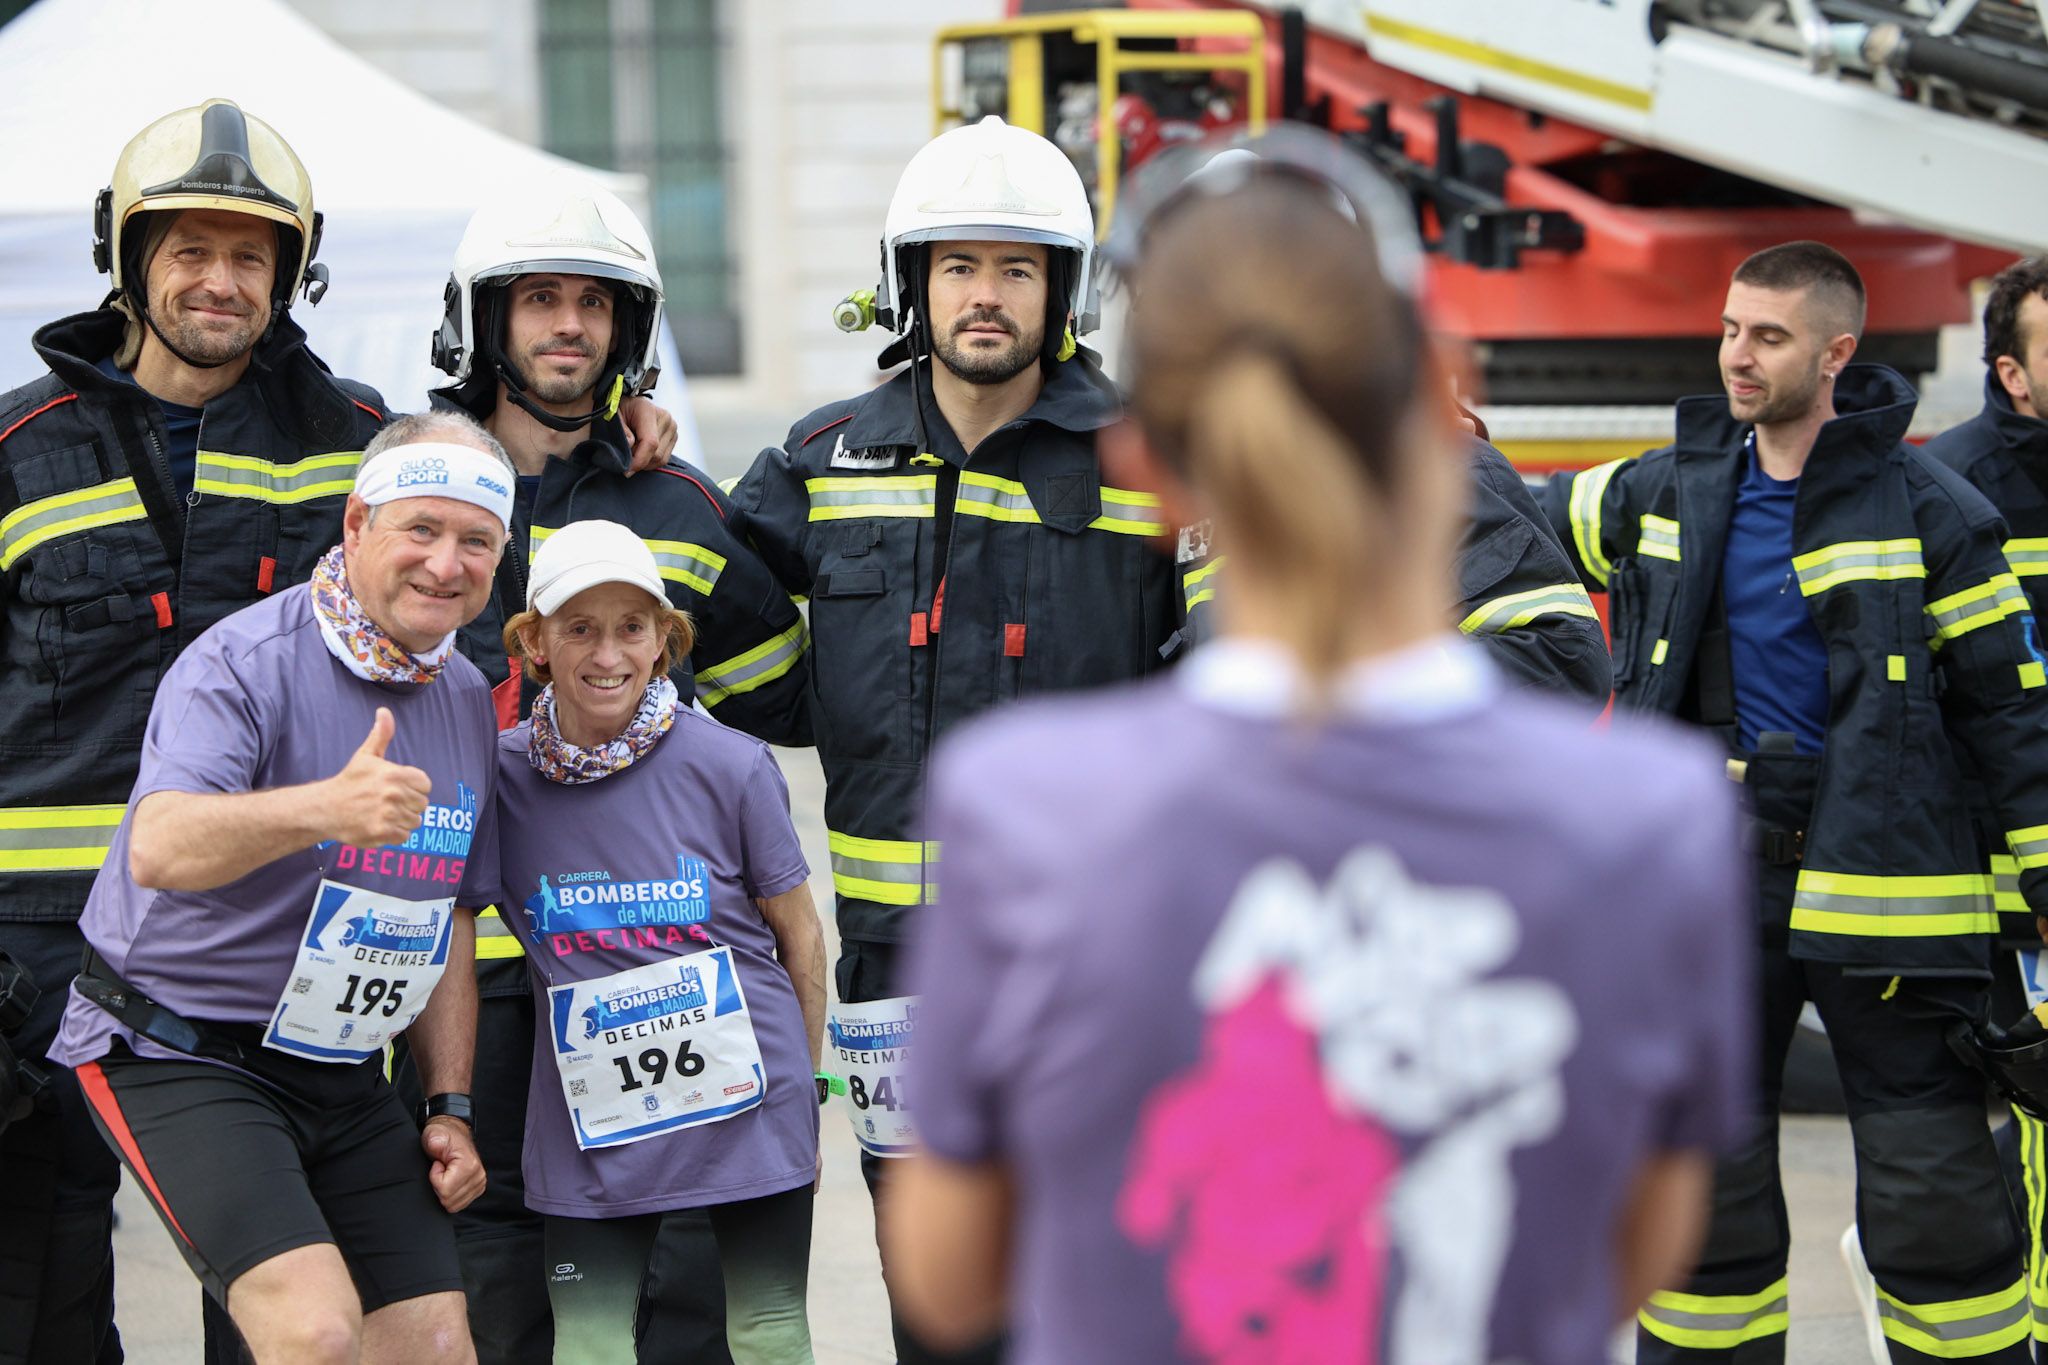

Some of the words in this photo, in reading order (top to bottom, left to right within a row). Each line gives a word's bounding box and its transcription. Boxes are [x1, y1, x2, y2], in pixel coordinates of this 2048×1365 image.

[181, 181, 222, 190] bomberos
[222, 183, 266, 196] aeropuerto
[399, 470, 447, 485] SPORT
[421, 805, 473, 832] EROS
[422, 827, 471, 856] MADRID
[336, 844, 465, 884] DECIMAS
[558, 870, 611, 884] CARRERA
[559, 879, 704, 907] BOMBEROS
[617, 904, 636, 924] de
[641, 899, 706, 923] MADRID
[374, 920, 436, 938] BOMBEROS
[552, 924, 708, 957] DECIMAS
[354, 947, 428, 966] DECIMAS
[335, 974, 409, 1018] 195
[607, 985, 641, 999] CARRERA
[608, 980, 700, 1013] BOMBEROS
[647, 1004, 661, 1018] de
[662, 991, 704, 1013] MADRID
[605, 1008, 706, 1045] DECIMAS
[841, 1020, 914, 1038] BOMBERO
[871, 1036, 884, 1049] de
[612, 1039, 706, 1093] 196
[840, 1049, 910, 1064] DECIMA
